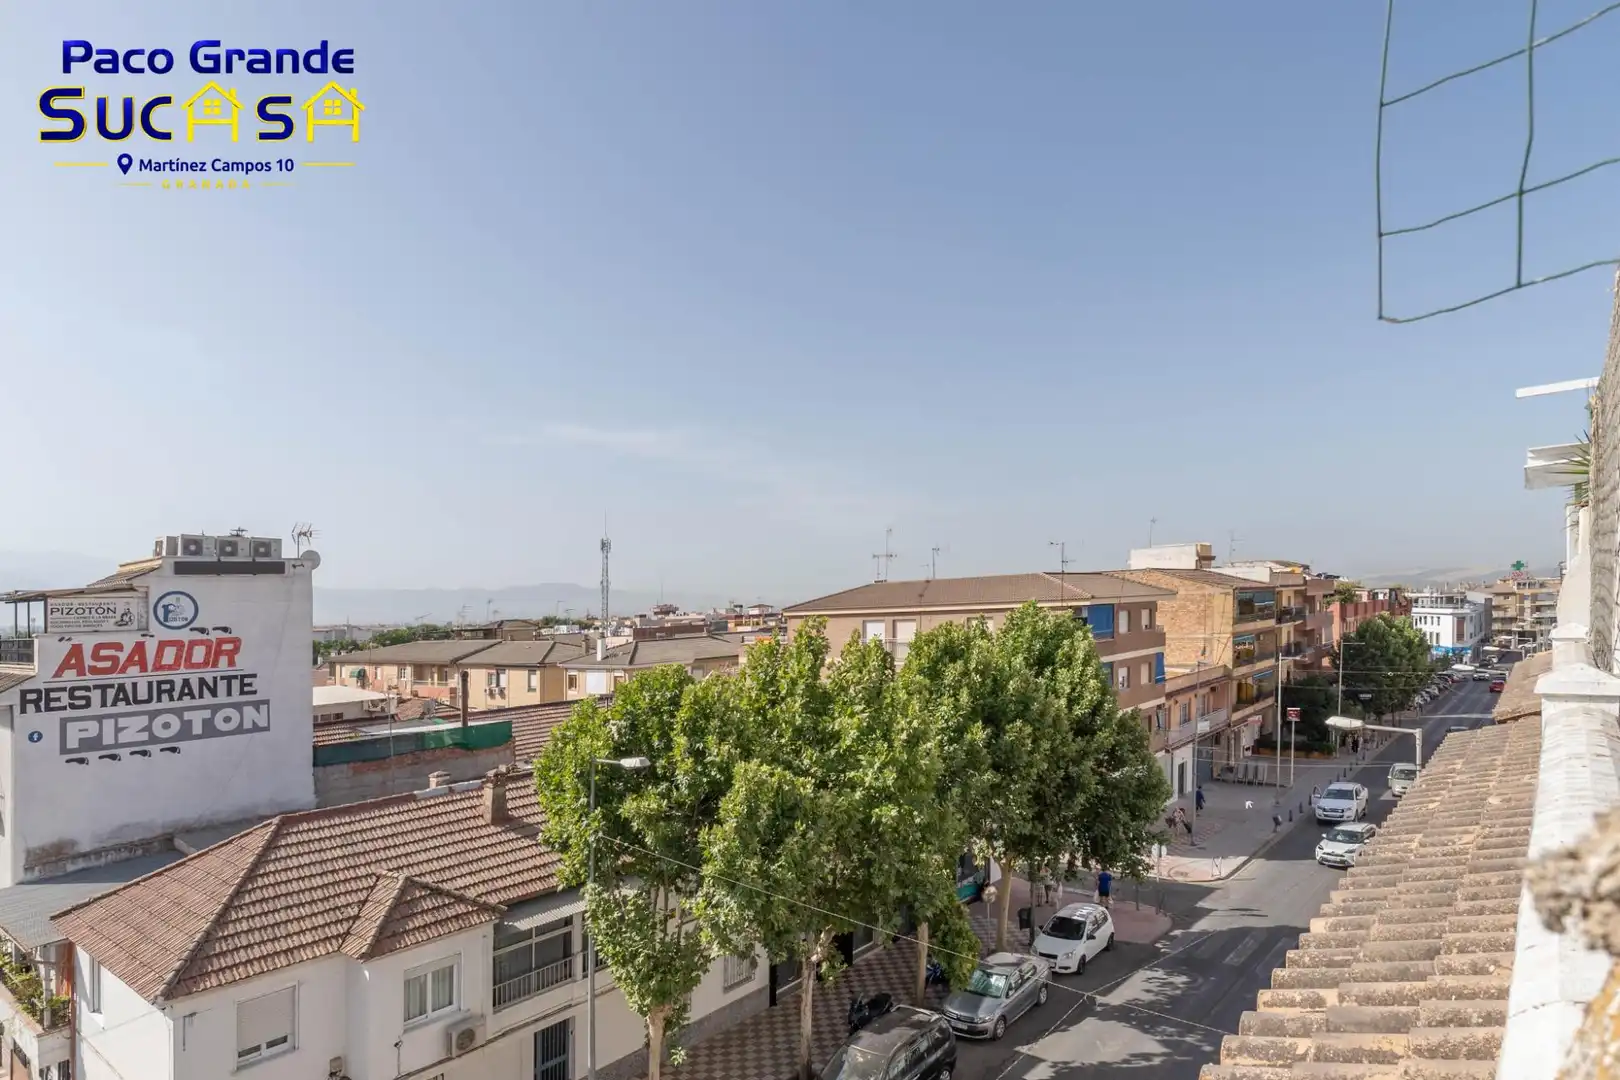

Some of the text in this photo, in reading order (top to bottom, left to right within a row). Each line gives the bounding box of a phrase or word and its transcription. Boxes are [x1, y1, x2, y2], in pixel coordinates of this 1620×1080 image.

[51, 637, 242, 679] ASADOR
[19, 673, 258, 715] RESTAURANTE
[66, 704, 268, 749] PIZOTON
